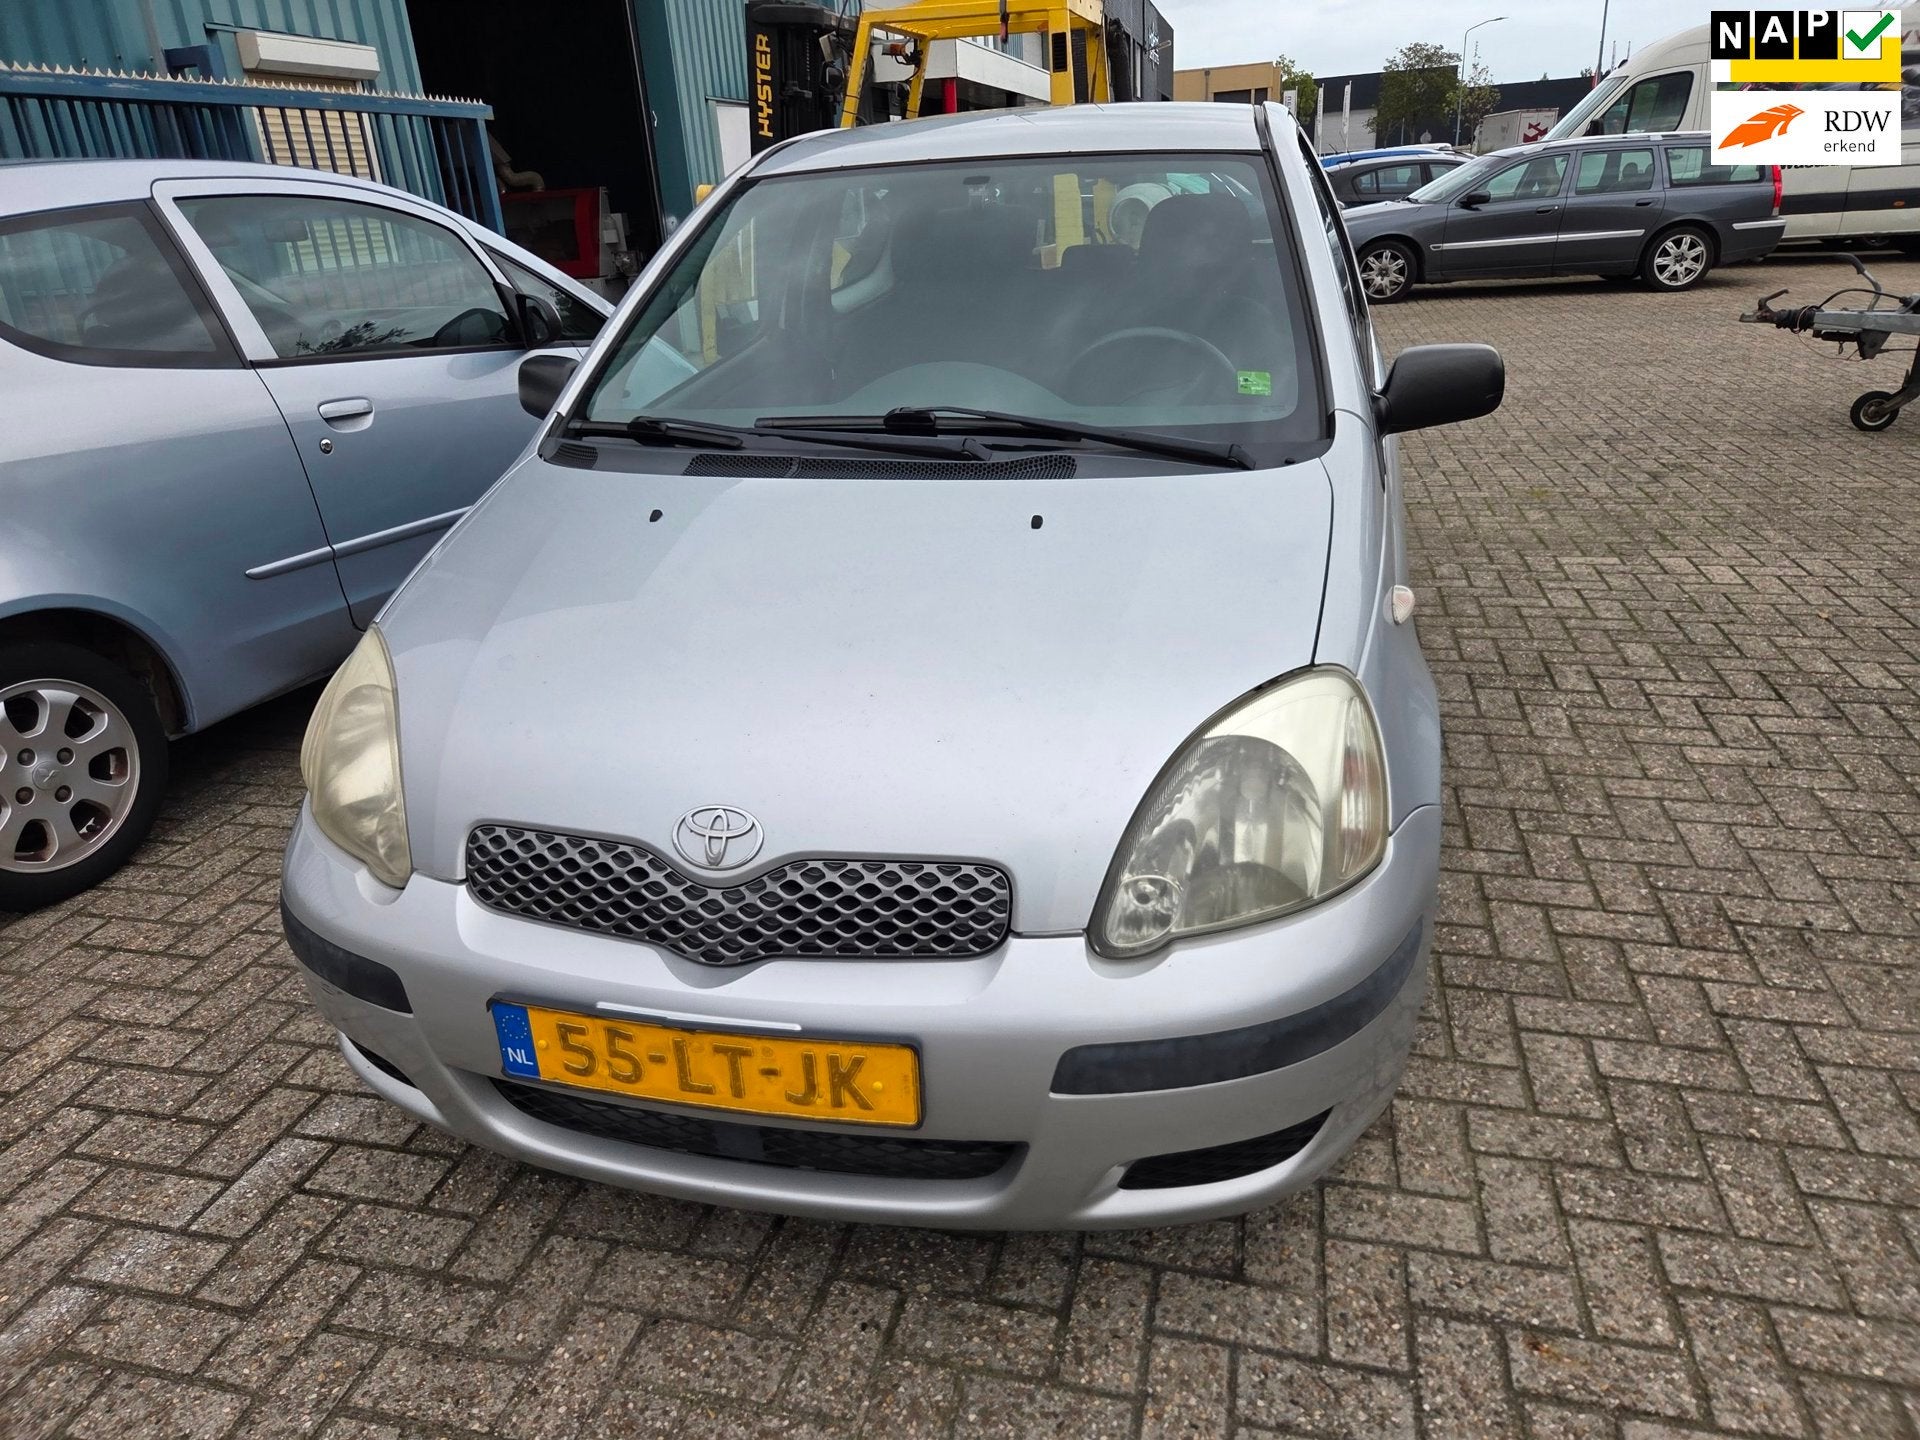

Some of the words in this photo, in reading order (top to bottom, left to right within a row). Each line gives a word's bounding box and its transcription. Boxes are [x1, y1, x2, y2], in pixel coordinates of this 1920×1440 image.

[756, 33, 773, 137] HYSTER
[507, 1046, 534, 1066] NL
[555, 1021, 875, 1111] 55-LT-JK
